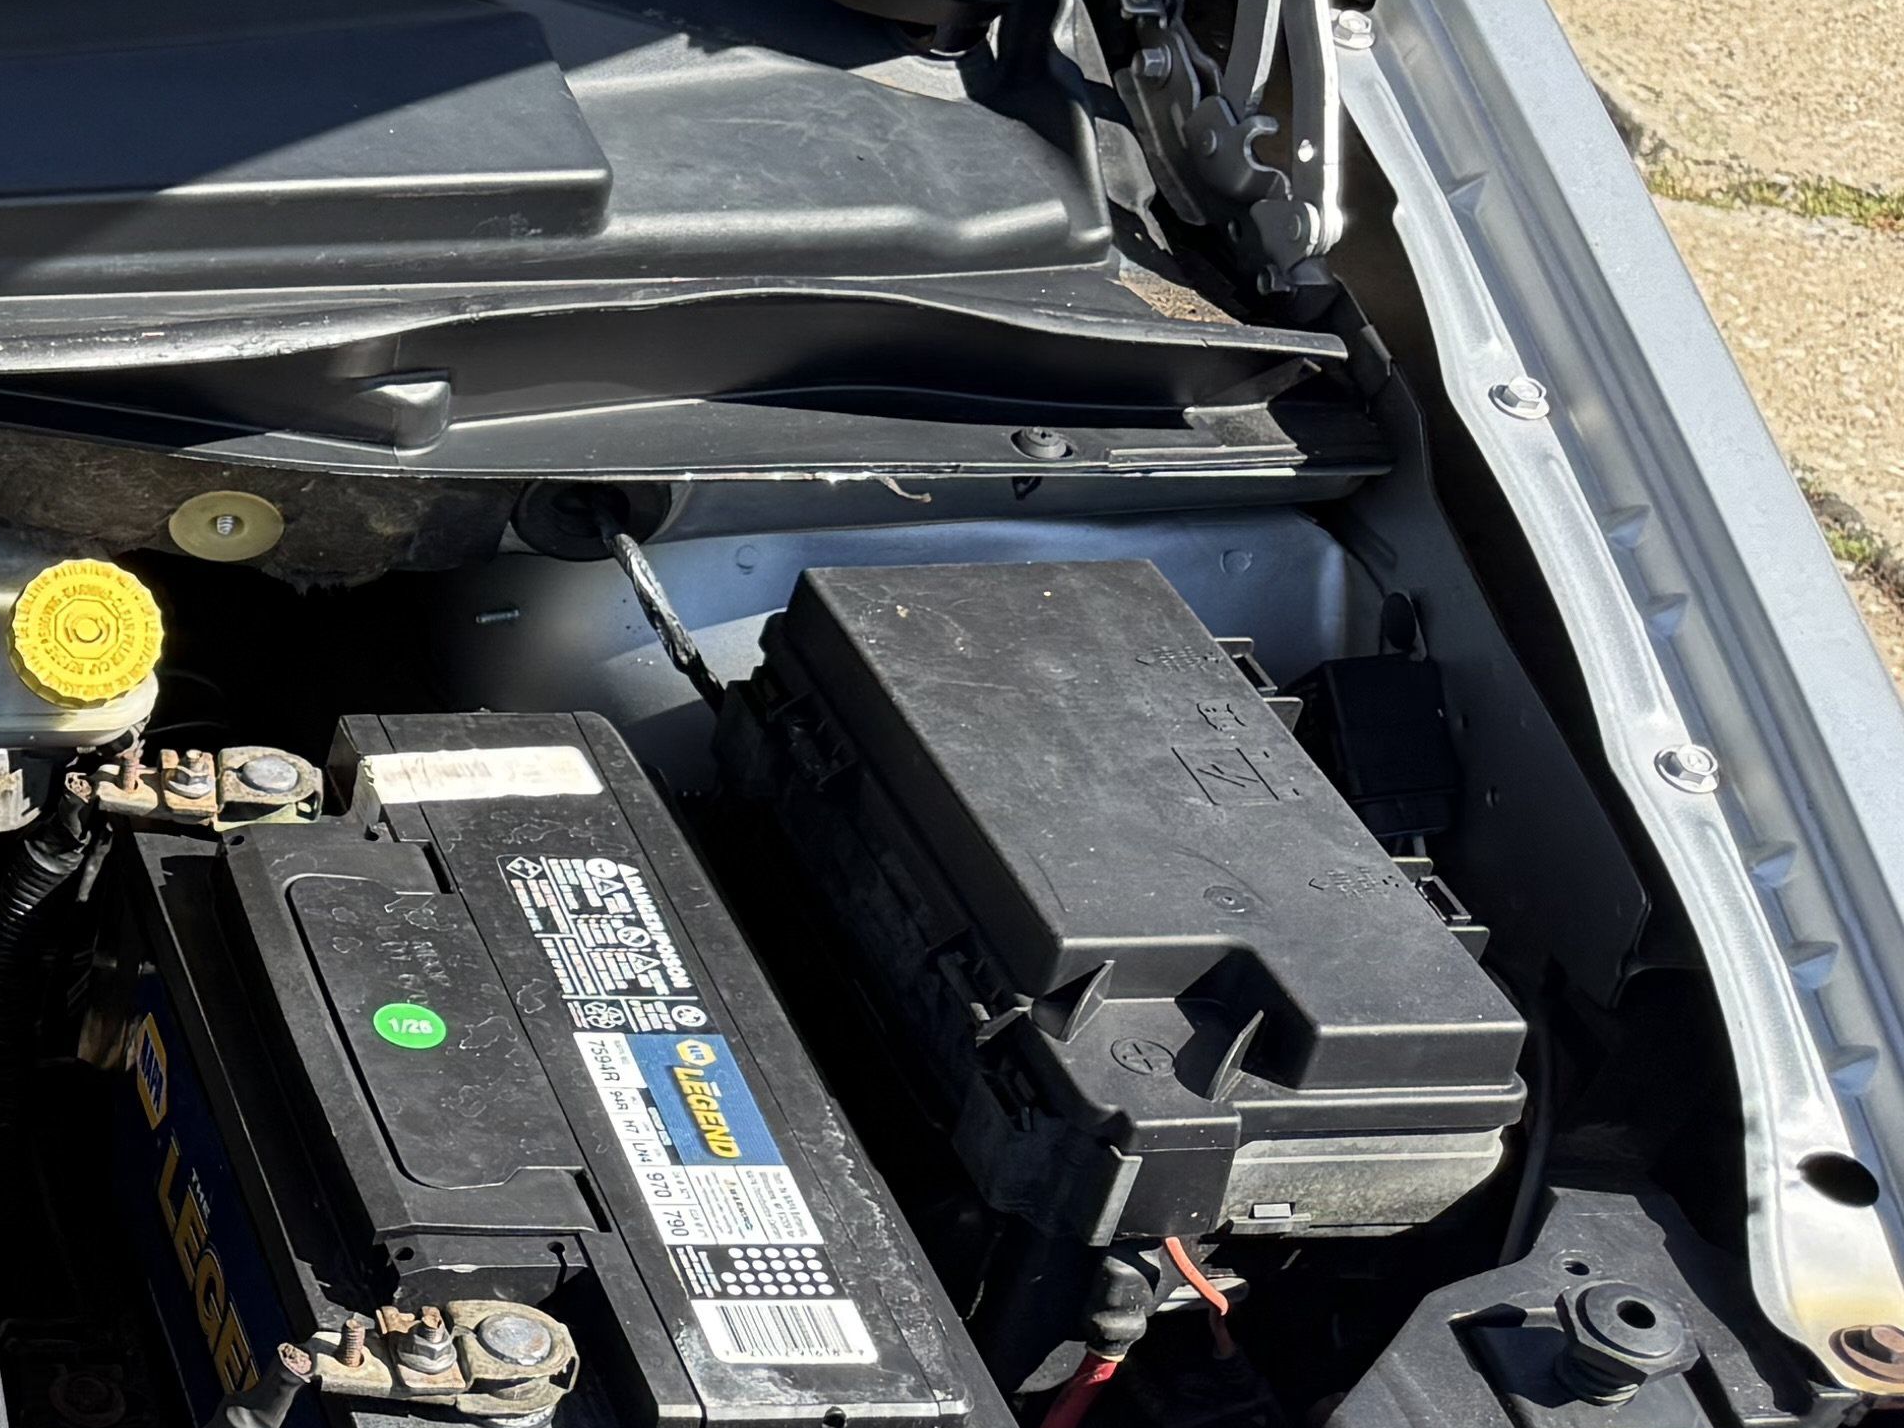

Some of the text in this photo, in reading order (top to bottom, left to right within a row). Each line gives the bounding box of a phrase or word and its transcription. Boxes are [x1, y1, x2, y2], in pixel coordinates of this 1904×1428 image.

[678, 1068, 741, 1159] LEGEND
[644, 1172, 672, 1197] 970
[661, 1211, 690, 1236] 790
